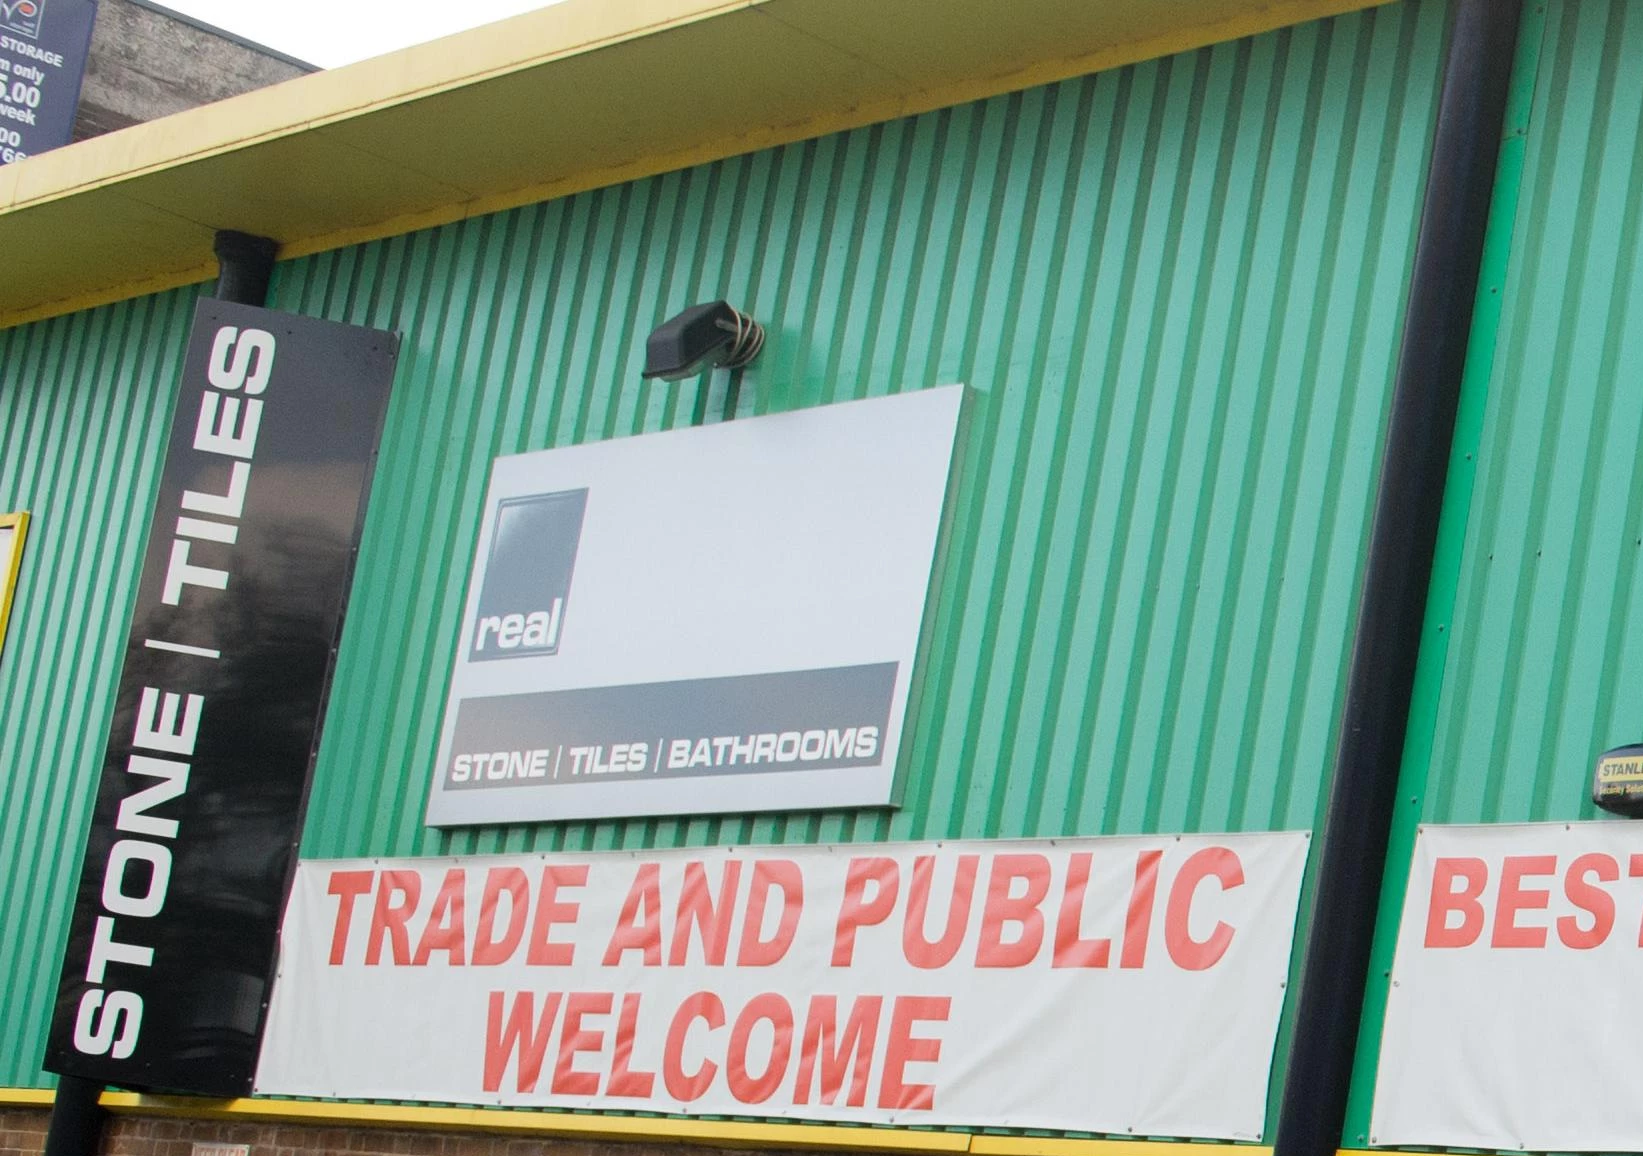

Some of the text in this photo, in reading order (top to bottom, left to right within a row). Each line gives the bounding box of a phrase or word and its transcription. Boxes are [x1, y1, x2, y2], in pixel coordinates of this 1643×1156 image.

[1, 35, 63, 67] STORAGE
[13, 63, 45, 85] only
[475, 598, 563, 652] real
[74, 687, 205, 1060] STONE
[162, 325, 276, 605] TILES
[452, 749, 549, 782] STONE
[569, 743, 648, 776] TILES
[667, 726, 879, 769] BATHROOMS
[328, 848, 1244, 969] TRADE AND PUBLIC
[484, 991, 951, 1110] WELCOME
